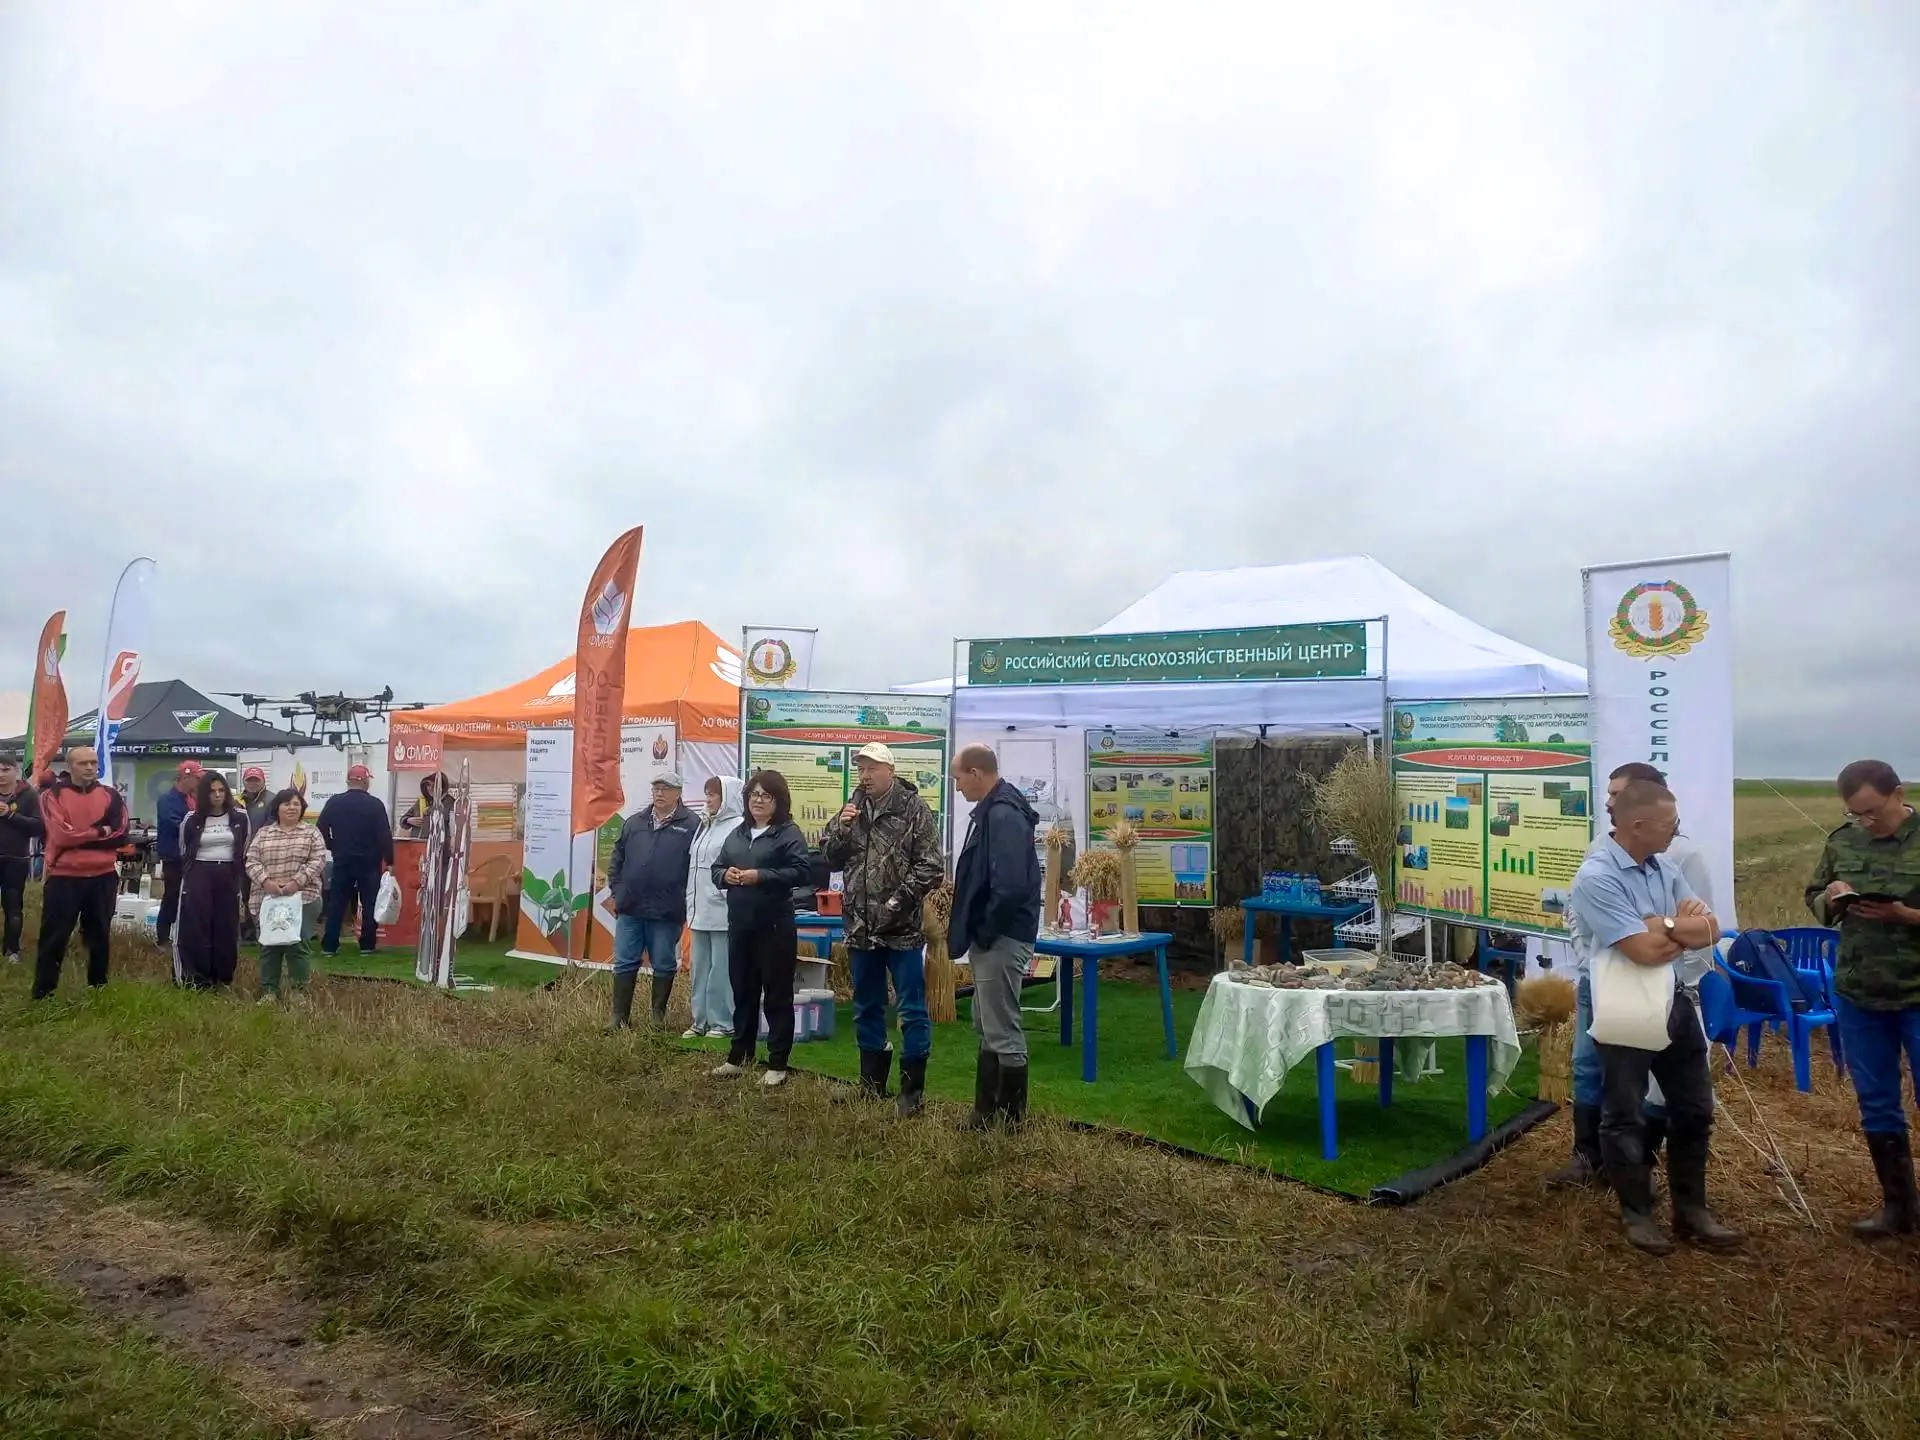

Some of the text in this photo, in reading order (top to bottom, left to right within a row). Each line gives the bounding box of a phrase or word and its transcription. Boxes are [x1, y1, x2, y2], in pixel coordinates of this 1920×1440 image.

[1004, 642, 1354, 670] РОССИЙСКИЙ СЕЛЬСКОХОЗЯЙСТВЕННЫЙ ЦЕНТР
[456, 720, 491, 732] РАСТЕНИЙ
[701, 717, 738, 728] АО ФМР
[1648, 671, 1669, 777] РОССЕЛ
[110, 745, 146, 753] RELICT
[406, 745, 438, 760] ФМРус
